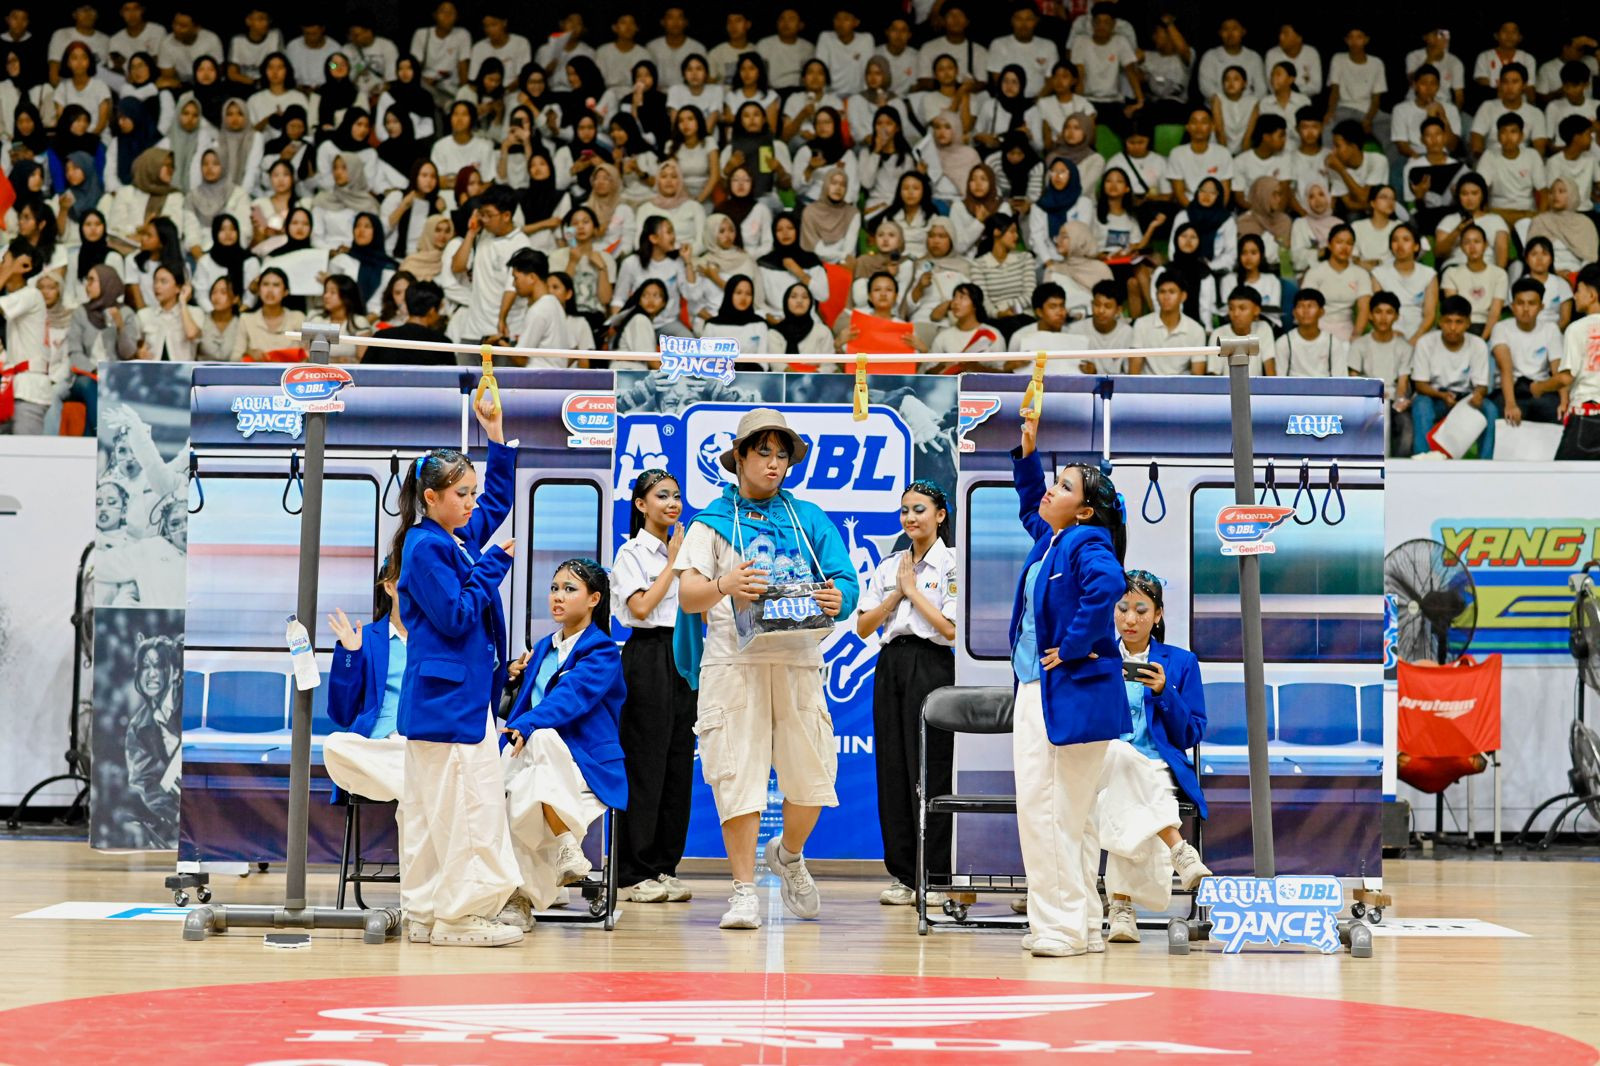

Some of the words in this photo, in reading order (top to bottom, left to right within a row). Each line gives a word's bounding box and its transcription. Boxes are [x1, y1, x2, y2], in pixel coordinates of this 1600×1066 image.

[714, 342, 737, 352] DBL
[305, 371, 345, 379] HONDA
[662, 355, 726, 381] DANCE
[305, 383, 325, 394] DBL
[233, 396, 272, 412] AQUA
[239, 412, 297, 437] DANCE
[587, 415, 609, 425] DBL
[1287, 414, 1342, 438] AQUA
[1236, 525, 1255, 534] DBL
[1441, 527, 1586, 567] YANG
[763, 597, 823, 621] AQUA
[1199, 879, 1275, 908] AQUA
[1298, 883, 1338, 900] DBL
[1212, 911, 1325, 954] DANCE
[284, 1029, 1252, 1055] HONDA
